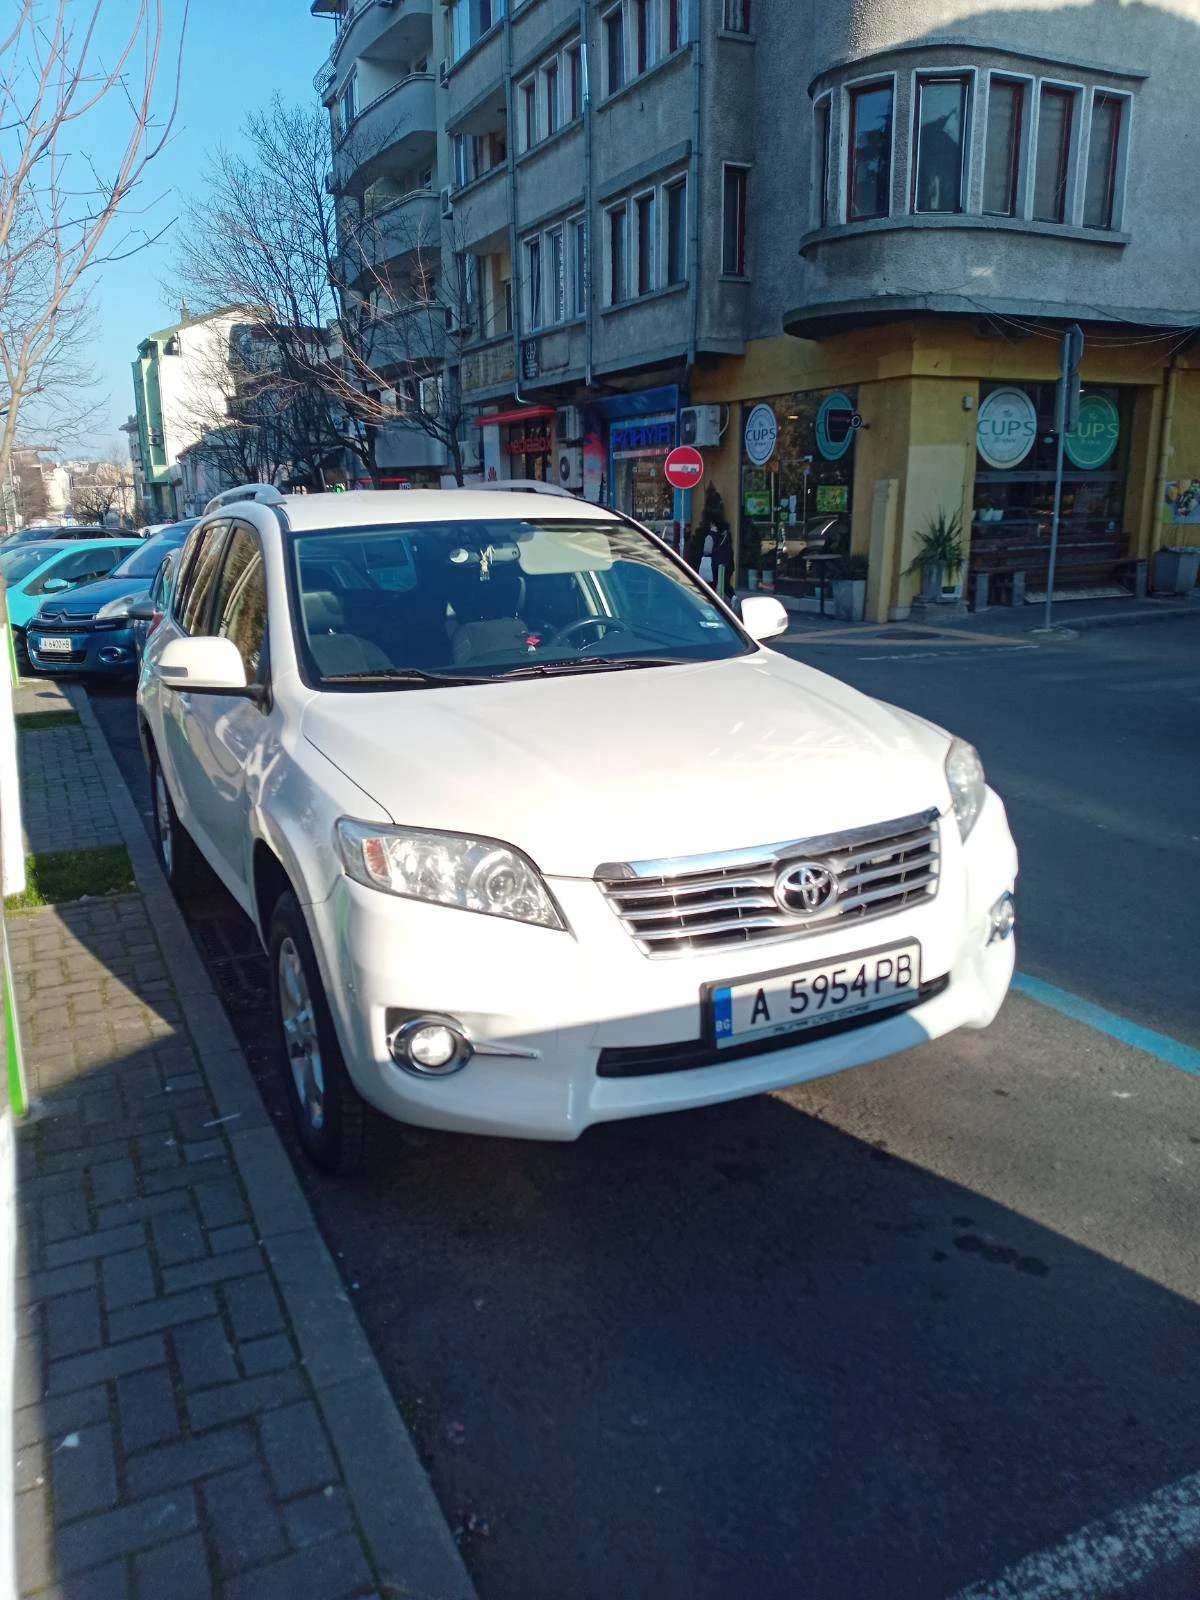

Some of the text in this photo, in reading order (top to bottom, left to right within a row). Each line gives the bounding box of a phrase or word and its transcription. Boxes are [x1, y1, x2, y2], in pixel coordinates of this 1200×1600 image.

[746, 428, 776, 441] CUPS
[977, 419, 1035, 436] CUPS
[715, 1018, 731, 1031] BG
[750, 988, 771, 1024] A
